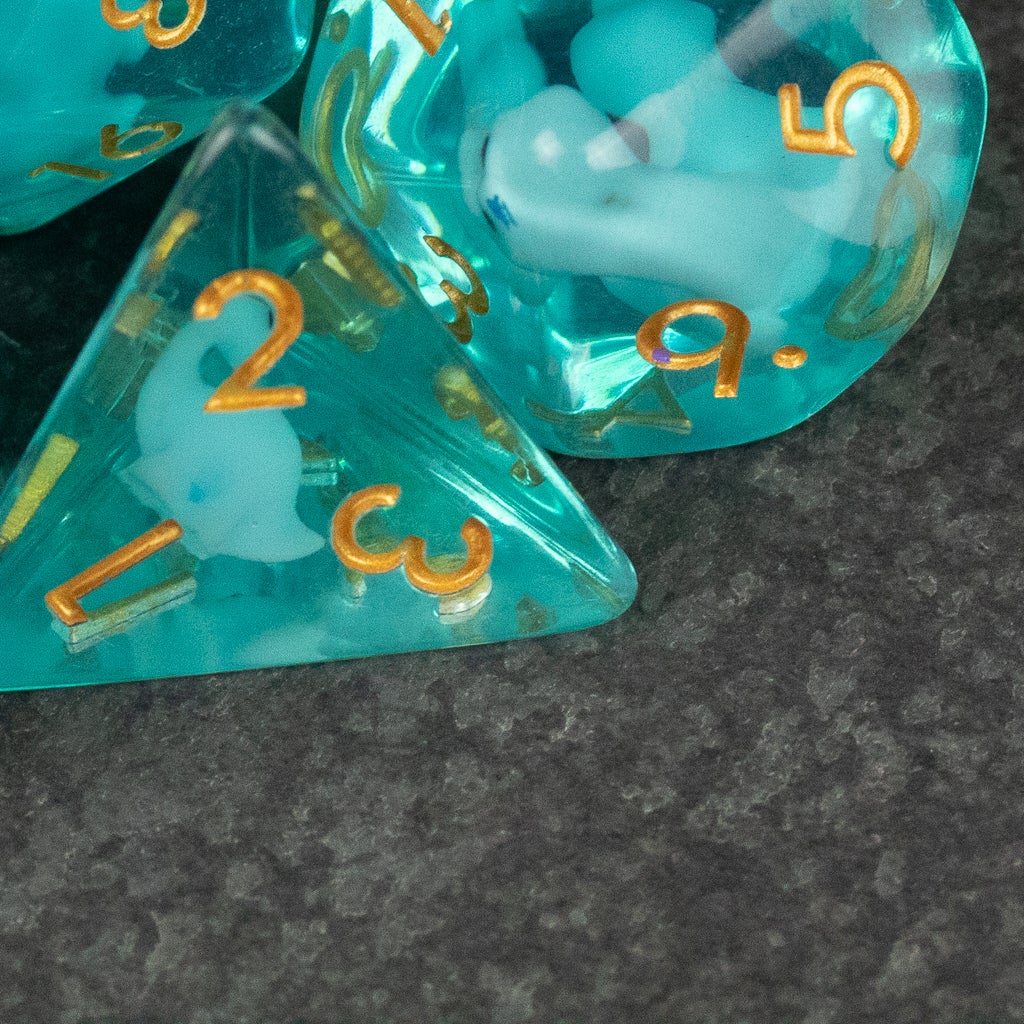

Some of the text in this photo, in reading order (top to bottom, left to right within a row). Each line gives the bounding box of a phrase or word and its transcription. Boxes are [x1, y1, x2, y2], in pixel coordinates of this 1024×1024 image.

[779, 60, 922, 168] 5
[193, 268, 307, 413] 2
[45, 518, 183, 626] 1
[330, 483, 494, 594] 3
